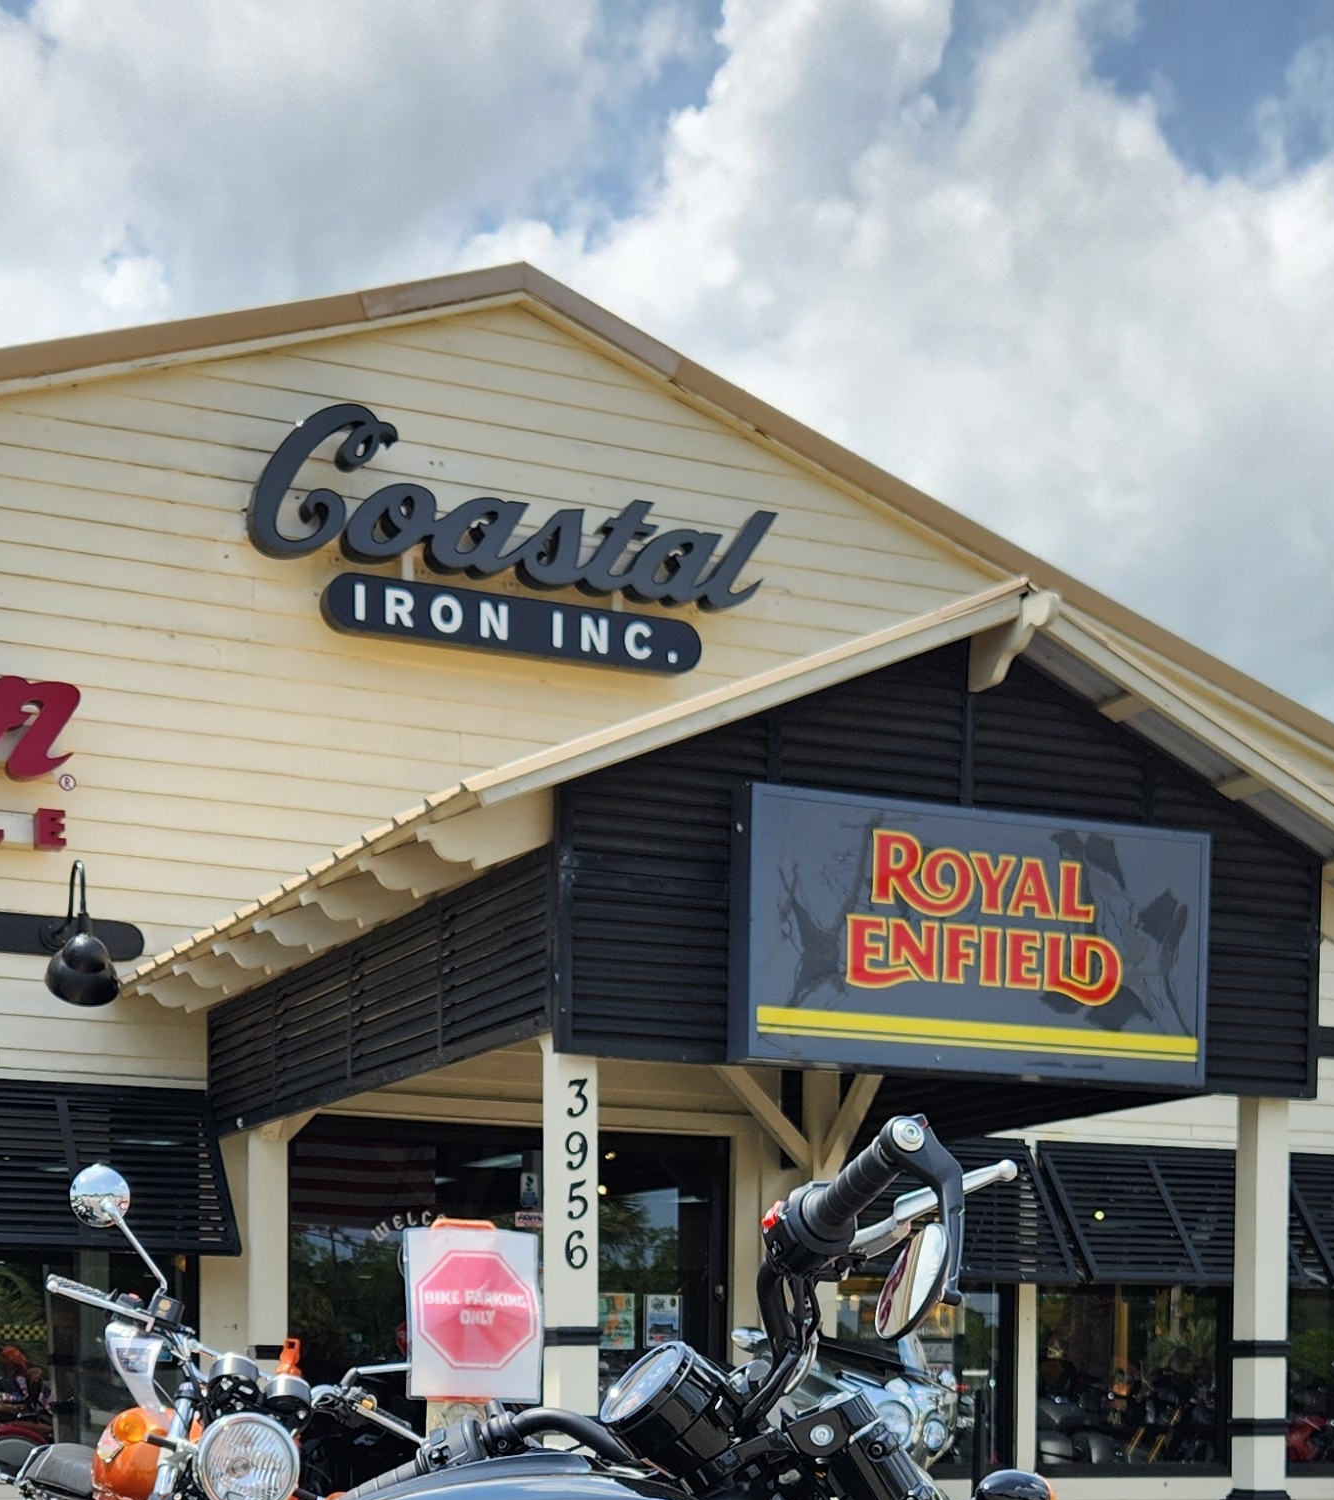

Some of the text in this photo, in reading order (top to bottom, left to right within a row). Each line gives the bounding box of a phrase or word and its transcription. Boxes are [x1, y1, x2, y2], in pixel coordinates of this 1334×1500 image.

[247, 403, 776, 611] Coastal
[354, 582, 680, 663] IRON INC.
[870, 828, 1095, 923] ROYAL
[845, 912, 1123, 1006] ENFIELD
[424, 1289, 528, 1308] BIKE PARKING
[459, 1310, 496, 1325] ONLY
